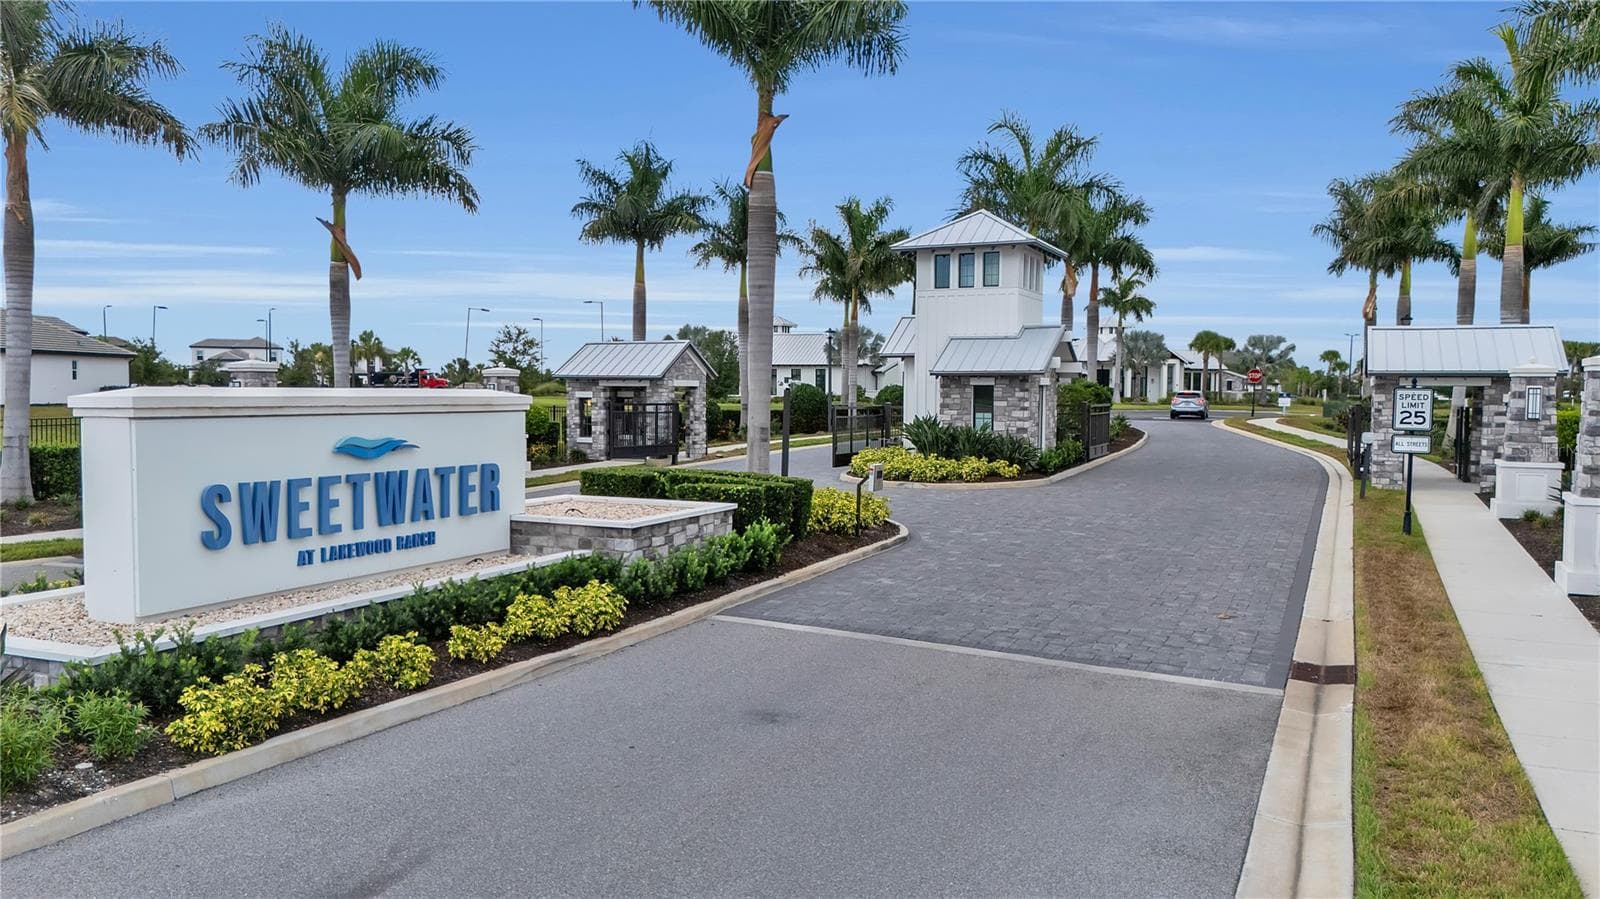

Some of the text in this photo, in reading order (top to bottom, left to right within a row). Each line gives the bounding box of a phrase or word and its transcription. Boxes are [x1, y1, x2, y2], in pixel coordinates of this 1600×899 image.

[1399, 410, 1426, 425] 25
[200, 463, 501, 550] SWEETWATER
[296, 531, 436, 566] AT LAKEWOOD RANCH
